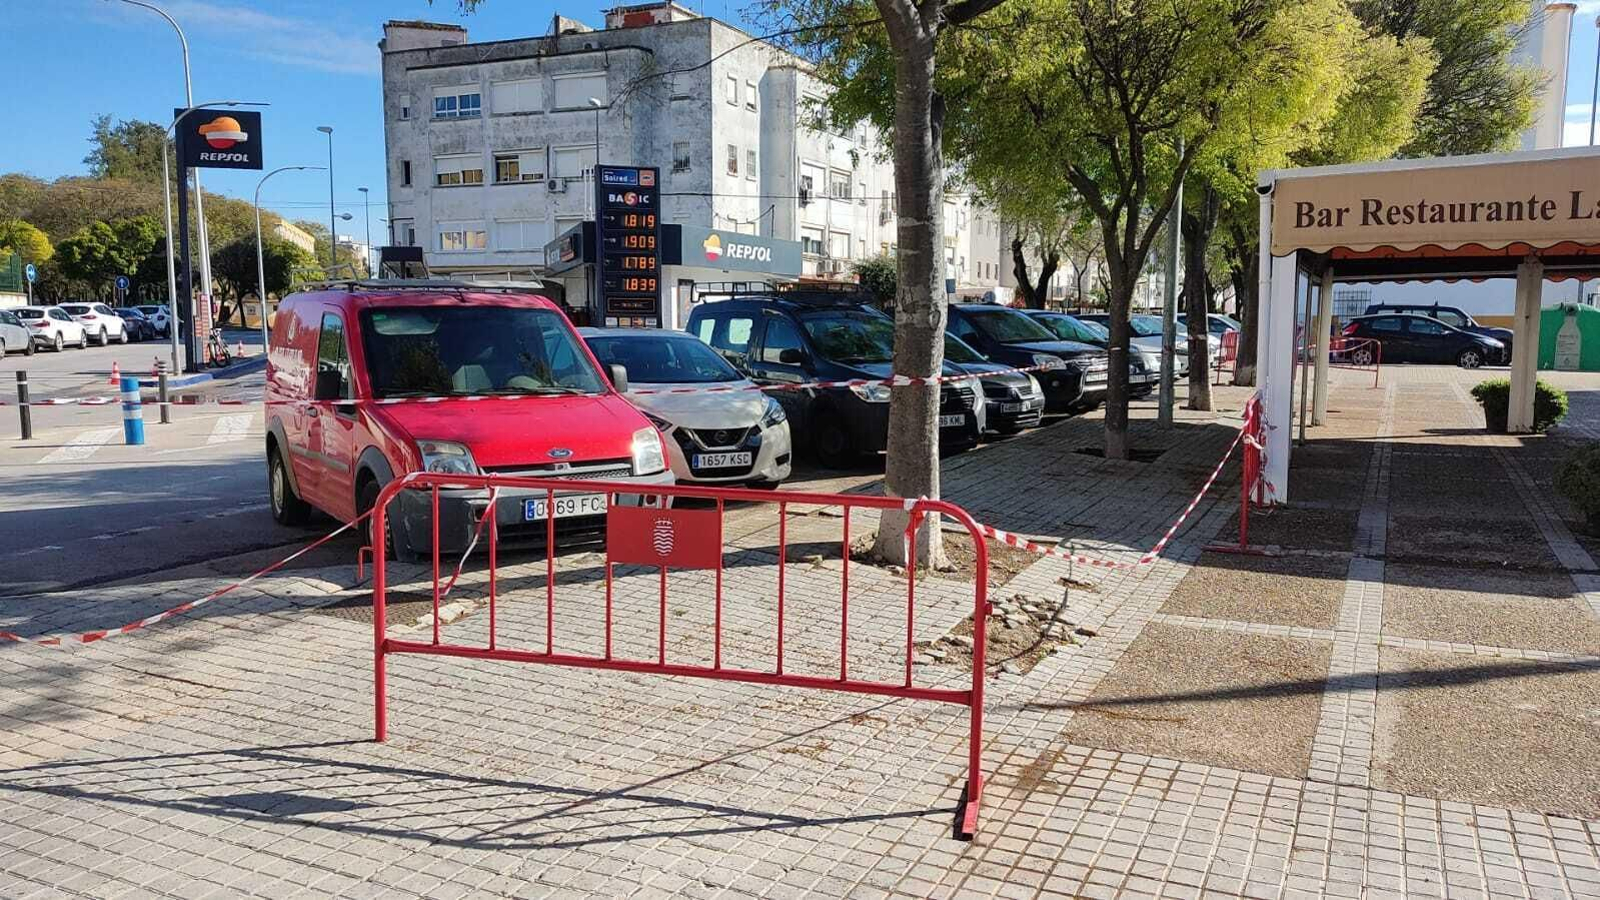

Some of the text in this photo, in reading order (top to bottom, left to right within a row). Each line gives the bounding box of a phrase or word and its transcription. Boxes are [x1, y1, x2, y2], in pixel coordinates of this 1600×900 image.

[200, 152, 249, 162] REPSOL
[1293, 201, 1351, 229] Bar
[1359, 194, 1557, 226] Restaurante
[727, 243, 772, 262] REPSOL
[702, 454, 727, 466] 1657
[536, 499, 575, 517] 069
